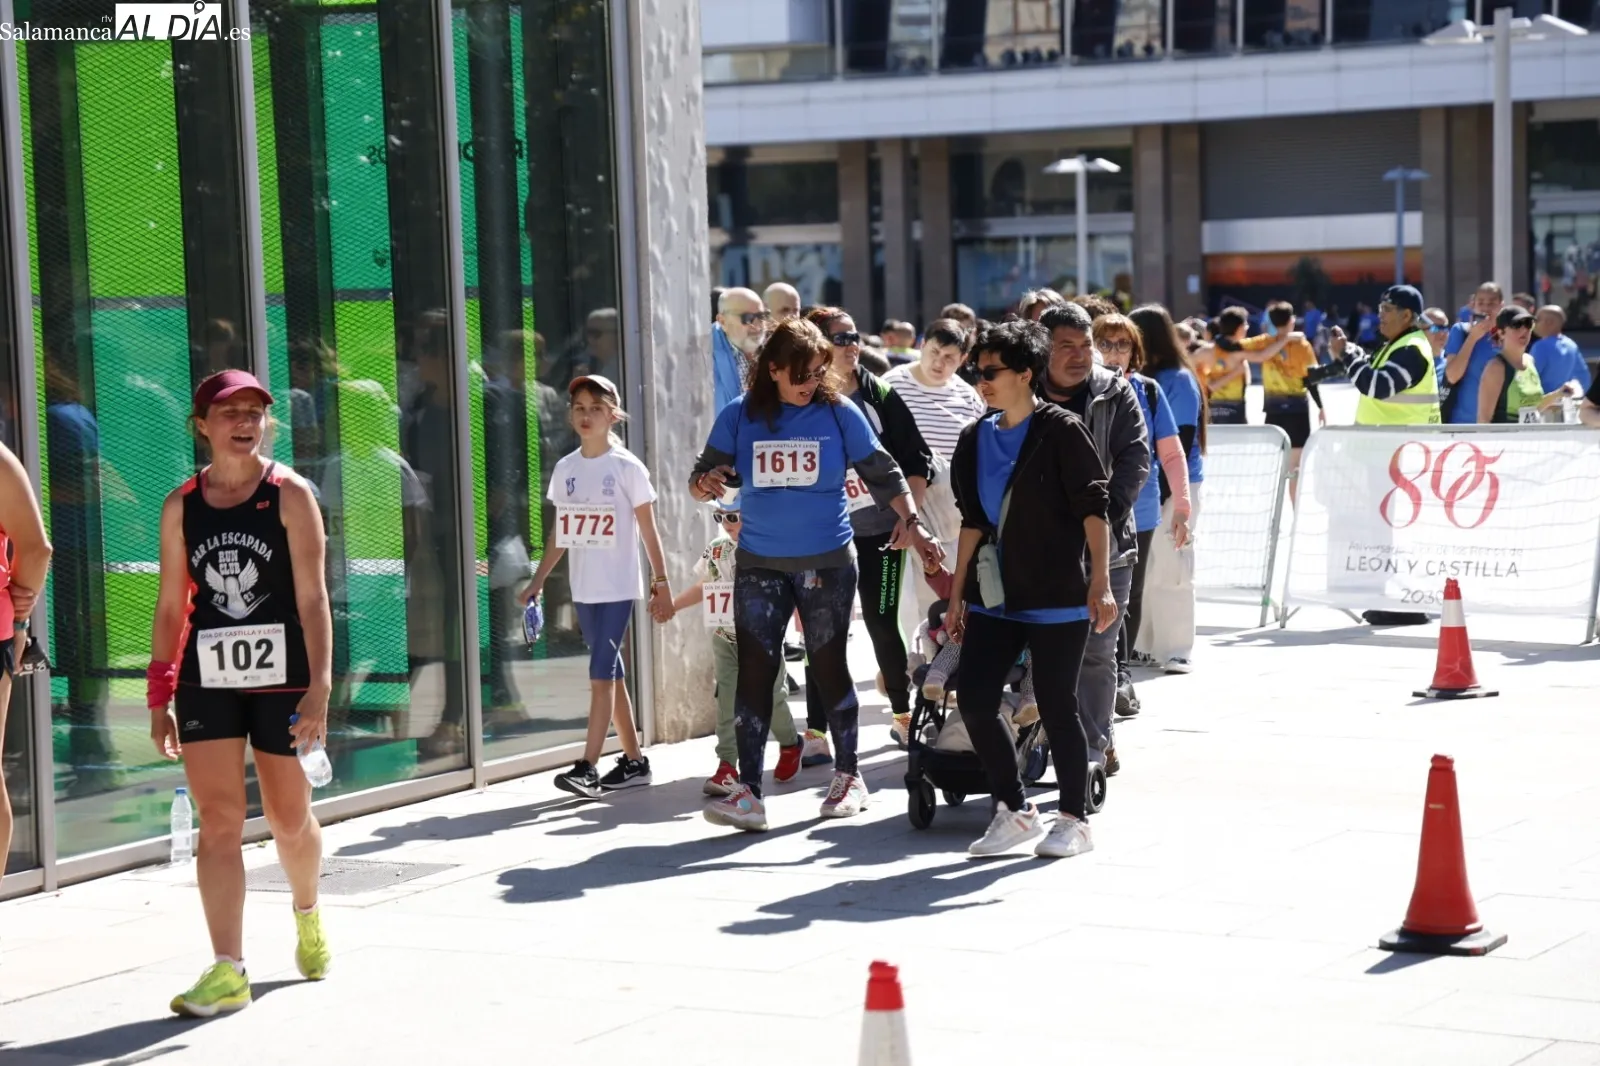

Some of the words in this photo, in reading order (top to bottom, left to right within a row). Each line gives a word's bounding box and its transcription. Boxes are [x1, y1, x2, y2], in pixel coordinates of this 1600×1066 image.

[756, 450, 817, 473] 1613
[560, 514, 614, 535] 1772
[207, 535, 221, 551] LA
[221, 532, 273, 562] ESCAPADA
[218, 549, 239, 563] RUN
[219, 562, 241, 576] CLUB
[1407, 559, 1419, 574] Y
[1426, 561, 1520, 578] CASTILLA
[879, 555, 889, 614] CORRECAMINOS
[224, 629, 257, 637] CASTILLA
[210, 638, 274, 671] 102
